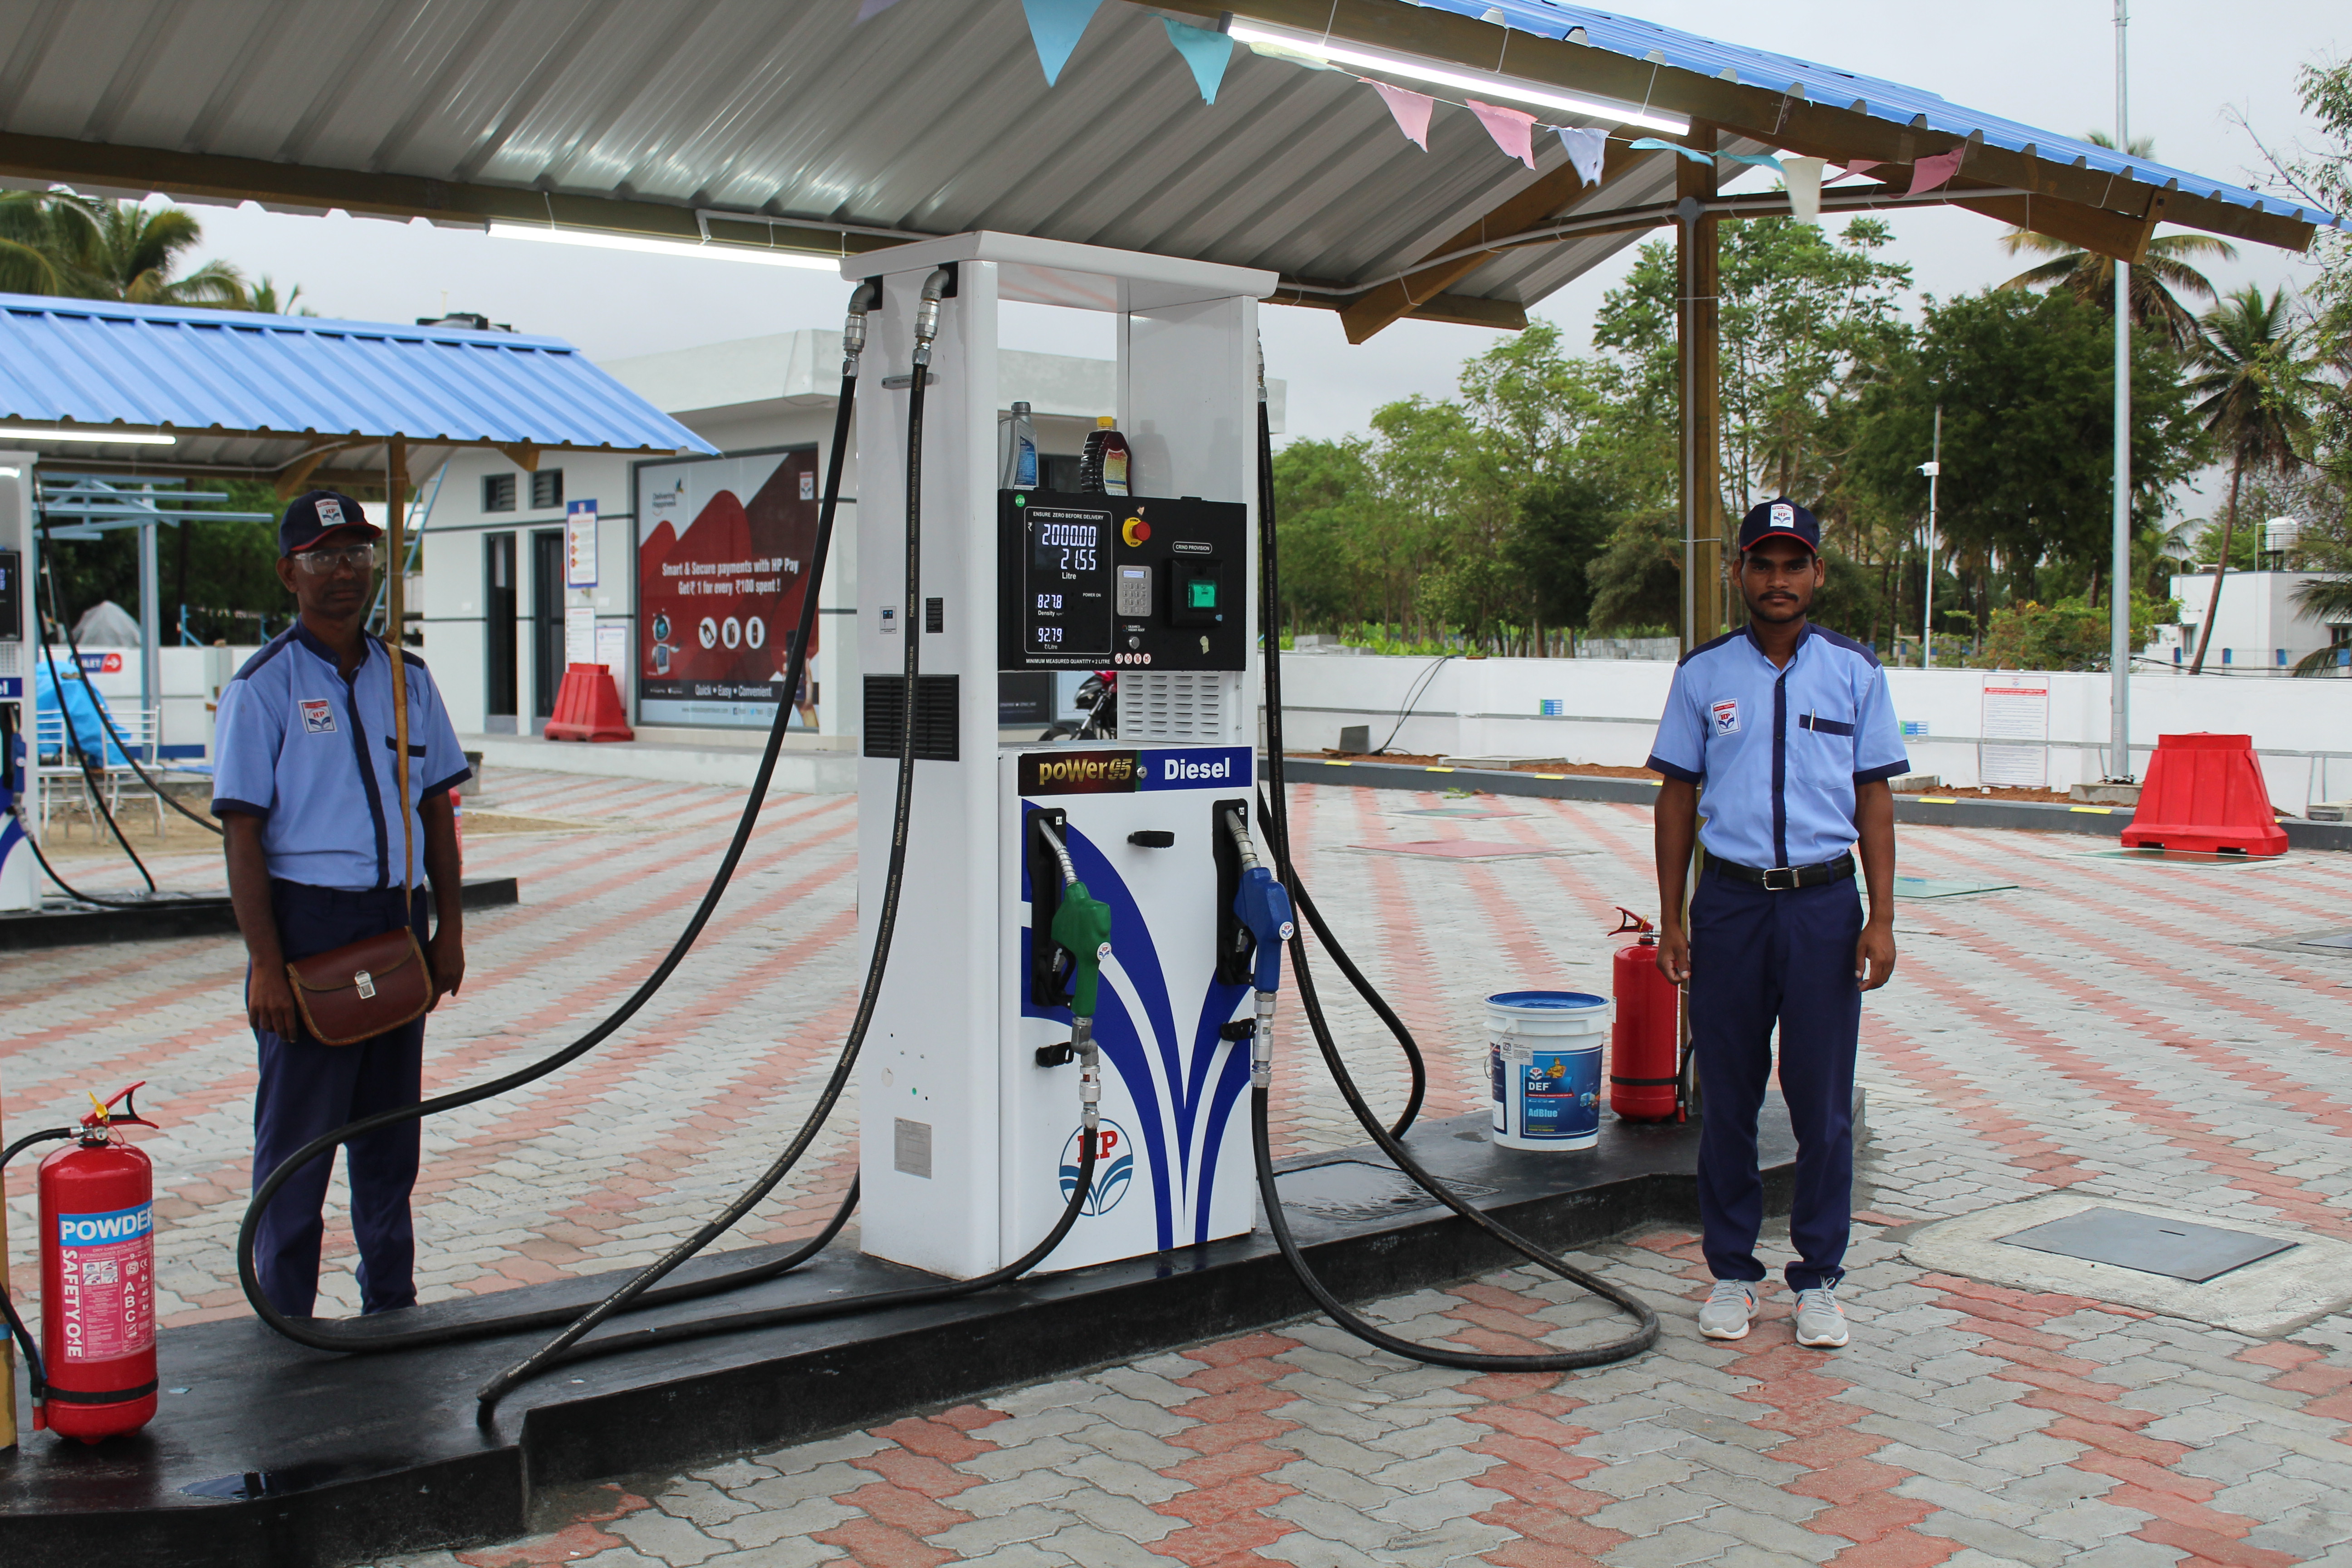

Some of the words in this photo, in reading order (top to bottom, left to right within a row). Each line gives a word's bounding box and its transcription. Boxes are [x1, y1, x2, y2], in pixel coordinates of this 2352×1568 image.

[1042, 524, 1097, 547] 2000.00
[1060, 548, 1096, 570] 21.55
[662, 562, 683, 576] Smart
[684, 562, 690, 575] &
[691, 561, 716, 575] Secure
[717, 560, 752, 577] payments
[754, 559, 770, 573] with
[771, 558, 783, 572] HP
[784, 558, 799, 574] Pay
[703, 580, 713, 594] for
[714, 582, 733, 597] every
[755, 578, 775, 596] spent
[1038, 594, 1062, 609] 827.8
[1038, 627, 1062, 642] 92.79
[695, 684, 711, 696] Quick
[718, 685, 732, 699] Easy
[738, 685, 772, 697] Convenient
[1164, 757, 1230, 780] Diesel
[1529, 1082, 1549, 1091] DEF
[1528, 1108, 1558, 1117] AdBlue
[124, 1282, 135, 1294] A
[125, 1295, 136, 1308] B
[125, 1310, 136, 1323] C
